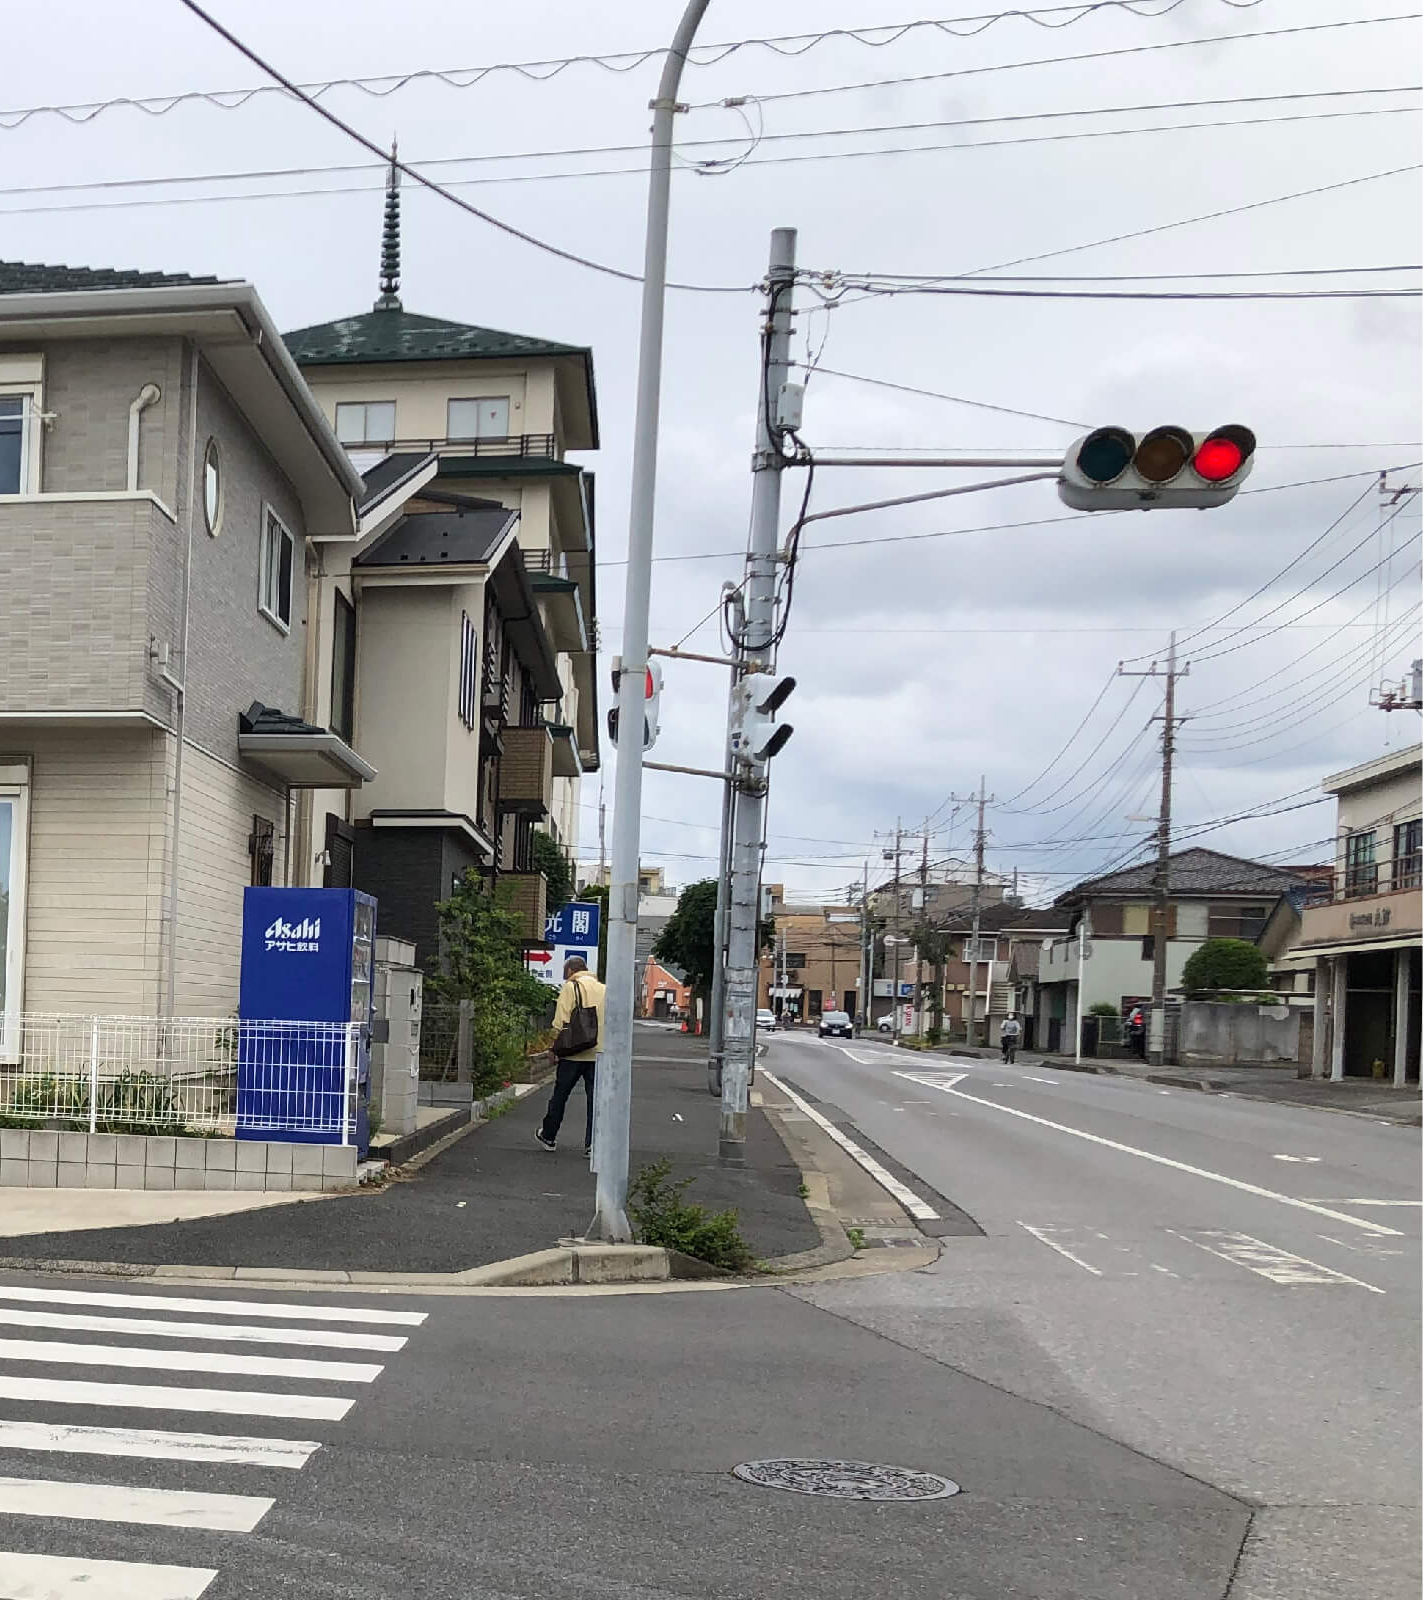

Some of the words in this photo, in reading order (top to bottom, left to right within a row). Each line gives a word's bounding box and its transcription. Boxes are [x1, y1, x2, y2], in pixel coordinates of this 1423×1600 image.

[265, 917, 321, 939] Asahi
[265, 940, 319, 952] アサヒ飲料
